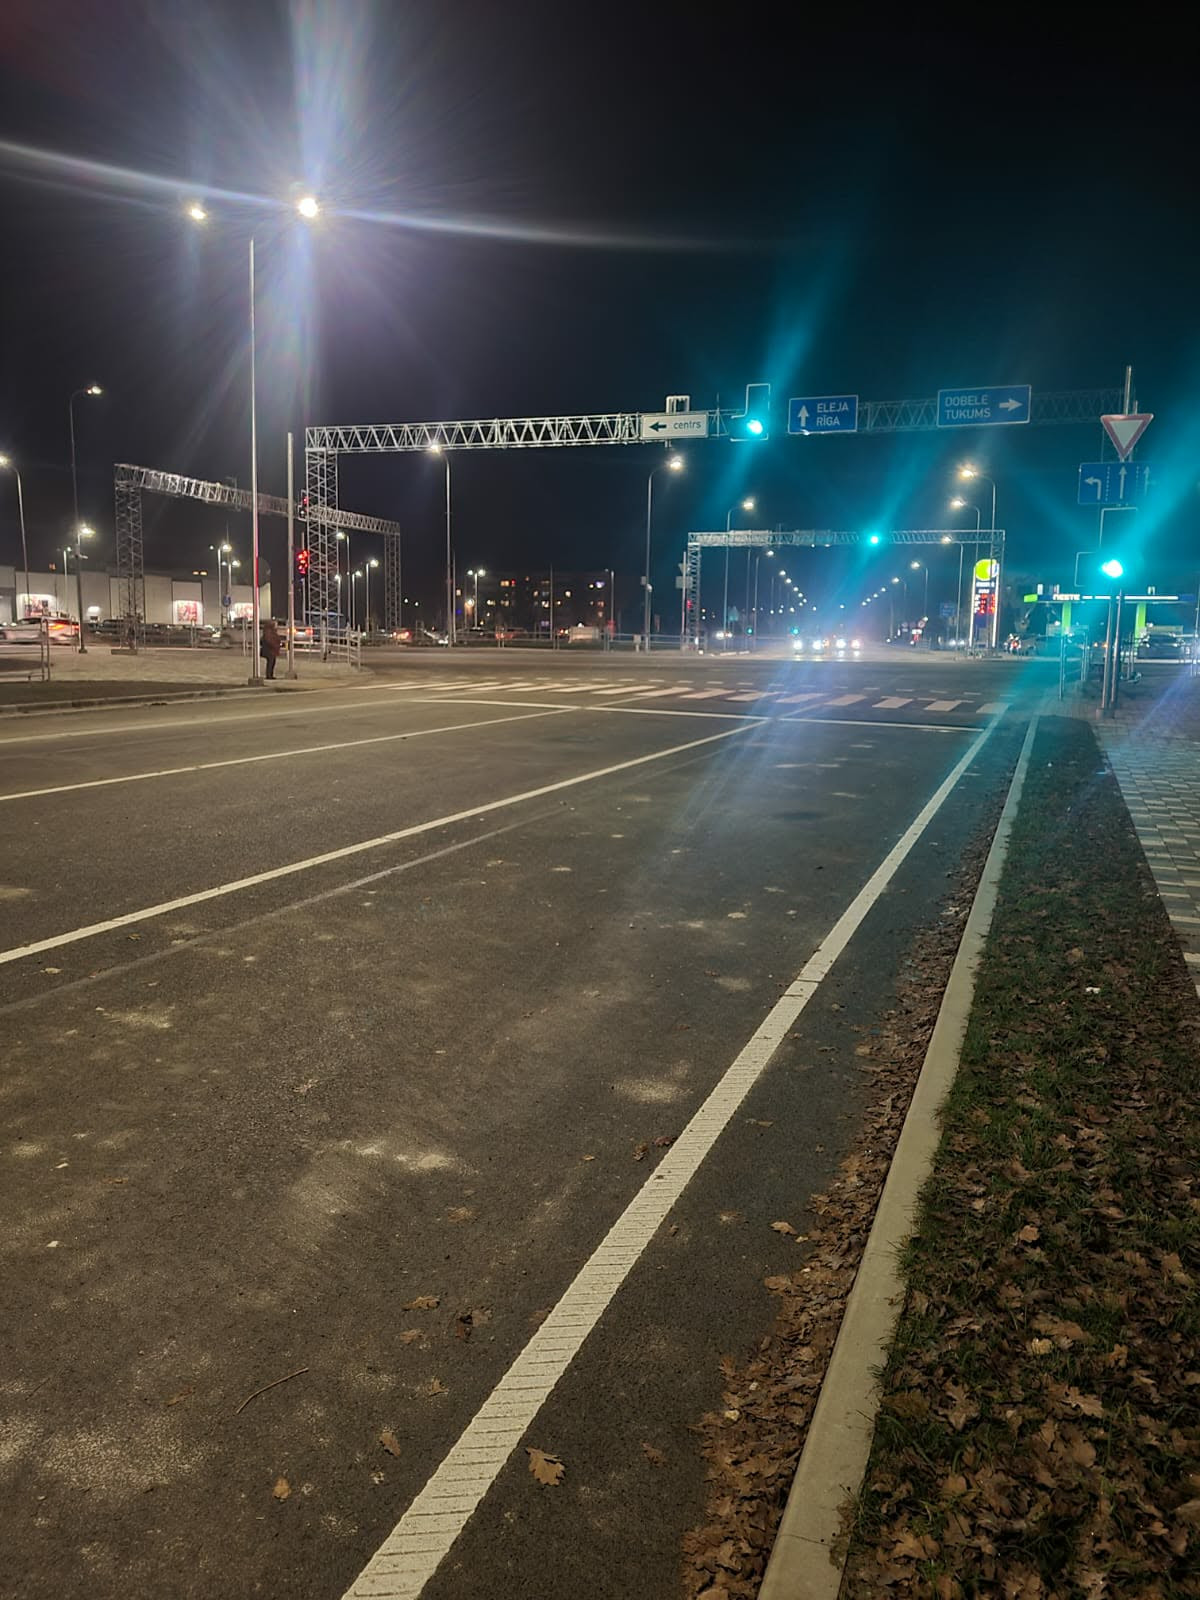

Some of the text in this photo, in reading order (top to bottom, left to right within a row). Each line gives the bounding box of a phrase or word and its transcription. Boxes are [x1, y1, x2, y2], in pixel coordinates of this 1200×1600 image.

[816, 401, 849, 413] ELEJA
[945, 394, 989, 407] DOBELE
[945, 407, 991, 420] TUKUMS
[673, 420, 702, 430] centrs
[816, 414, 840, 427] RĪGA
